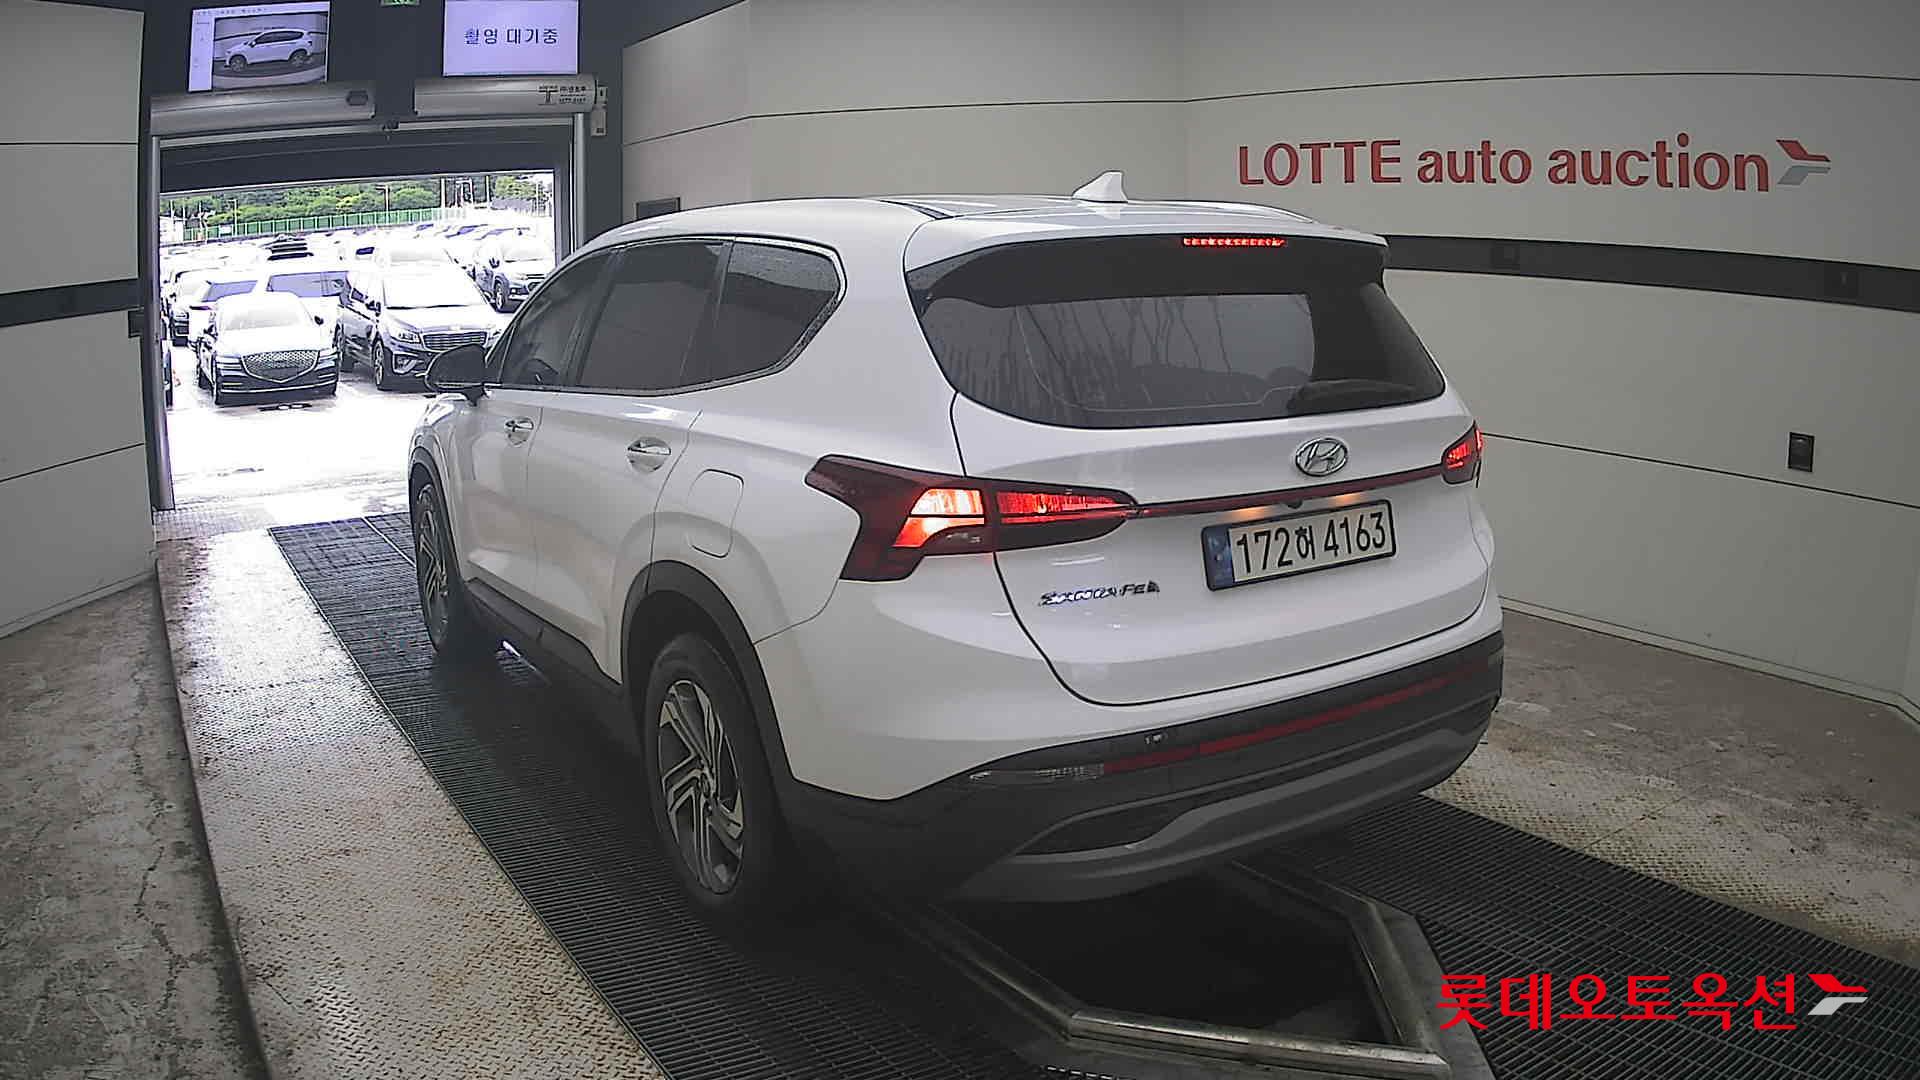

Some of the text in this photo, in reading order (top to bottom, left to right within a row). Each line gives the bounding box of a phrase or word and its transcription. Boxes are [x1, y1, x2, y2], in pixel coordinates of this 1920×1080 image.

[506, 28, 558, 45] 대기중
[1239, 134, 1769, 192] LOTTE auto auction
